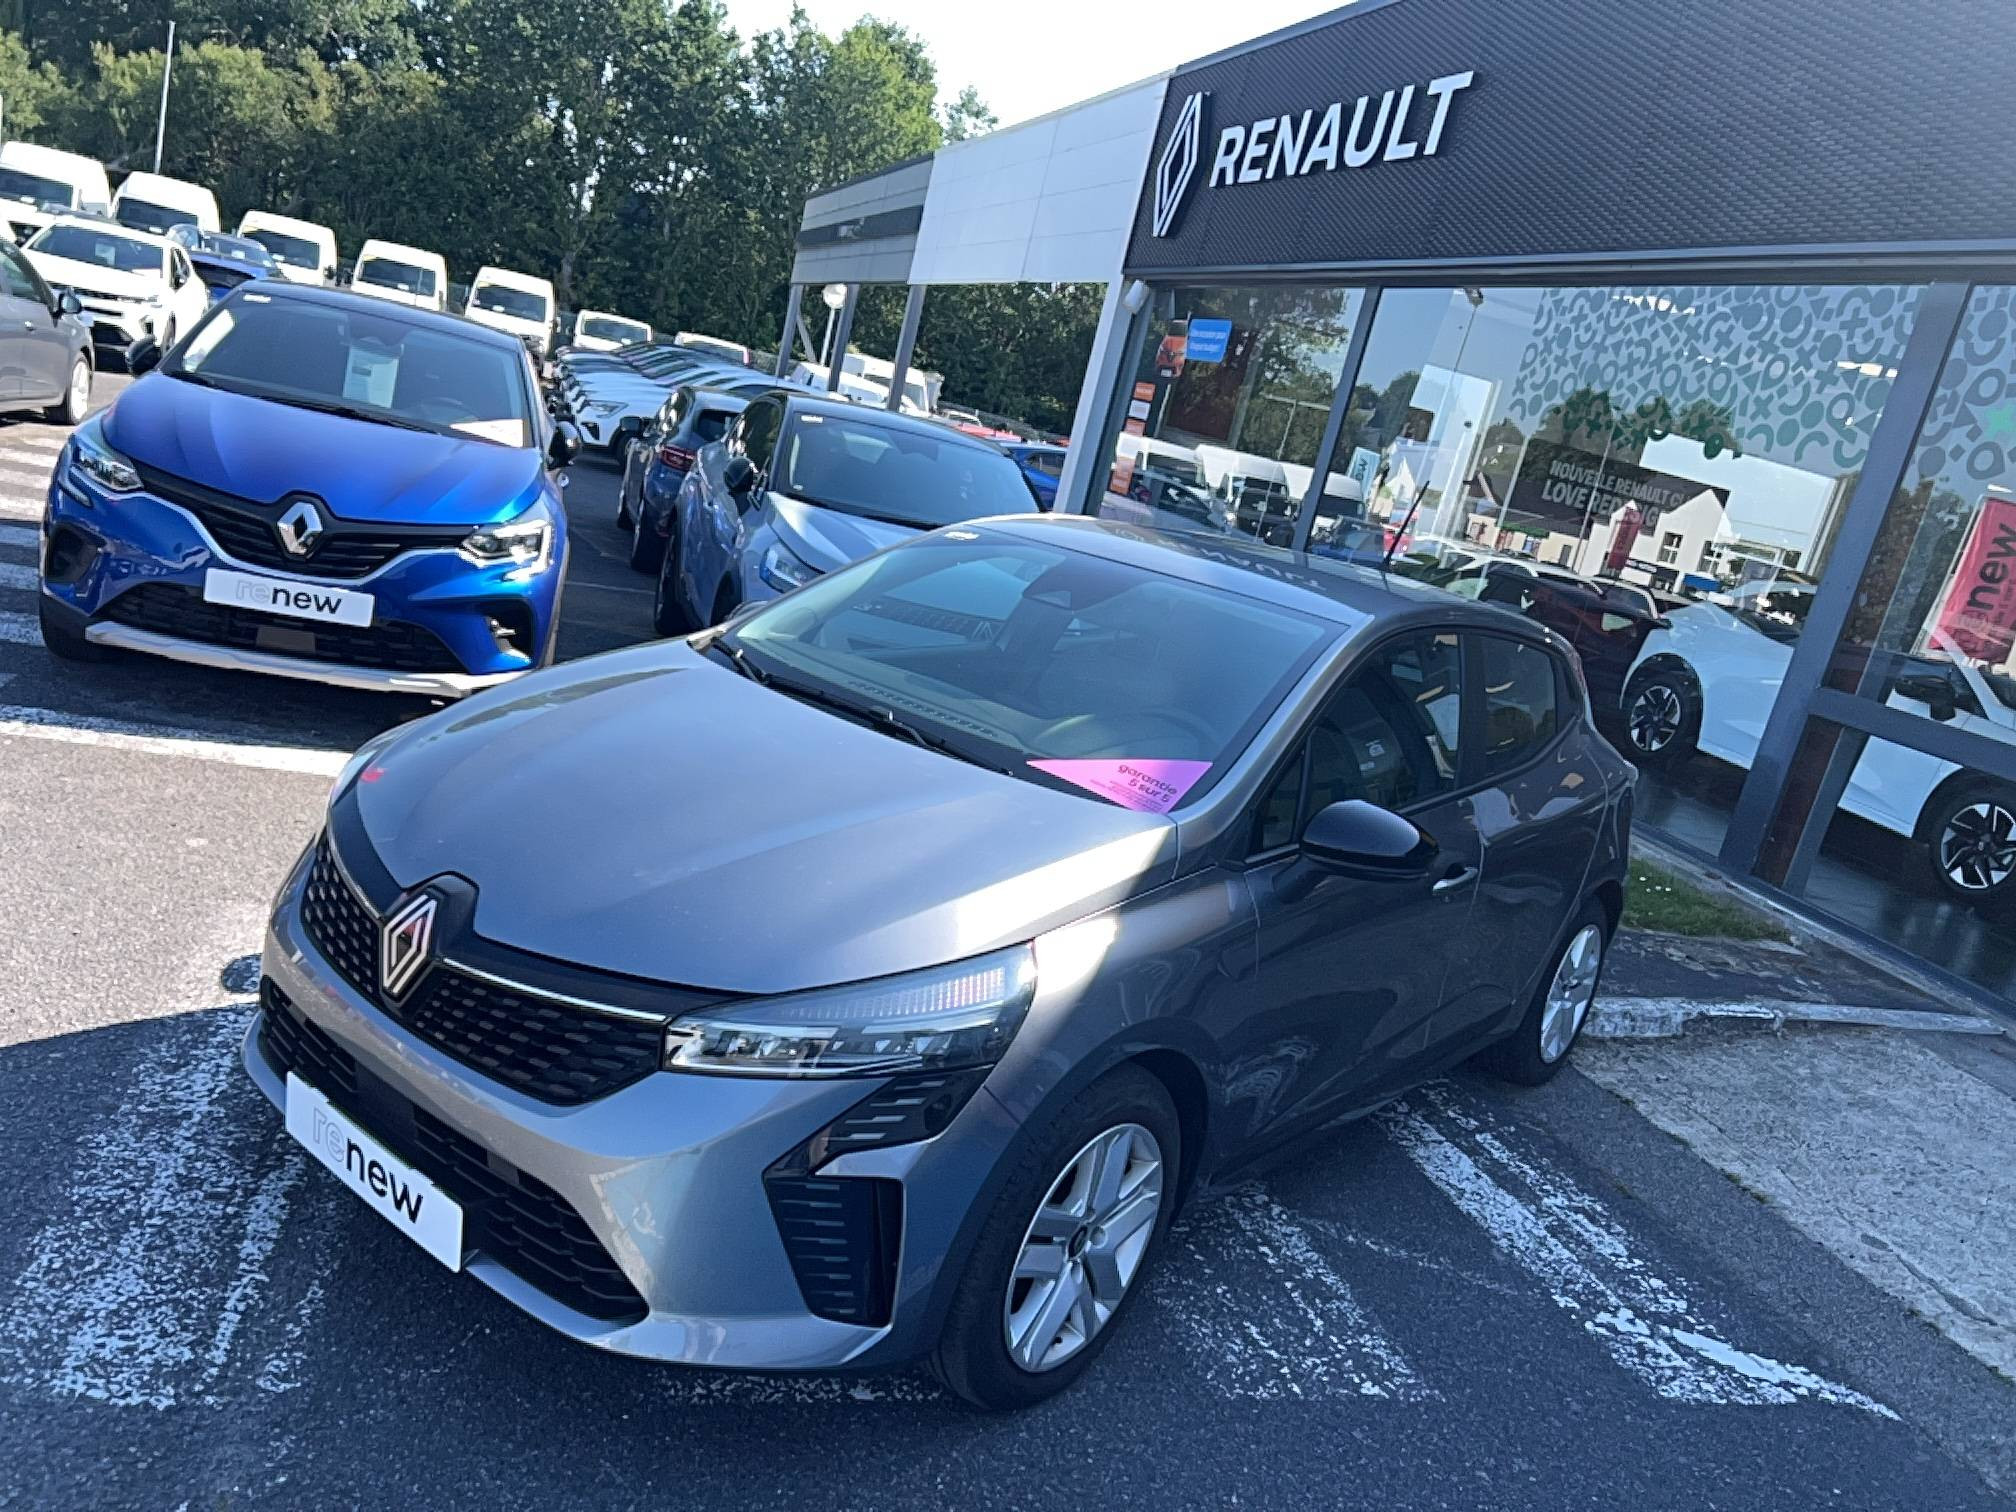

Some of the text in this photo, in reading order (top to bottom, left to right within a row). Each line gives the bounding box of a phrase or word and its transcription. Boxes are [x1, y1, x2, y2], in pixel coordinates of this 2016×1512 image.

[1209, 71, 1474, 188] RENAULT
[1541, 478, 1588, 508] LOVE
[1614, 477, 1671, 505] RENAULT
[235, 580, 342, 614] renew
[1118, 764, 1178, 795] garantie
[1138, 784, 1162, 797] sur
[312, 1107, 424, 1224] renew
